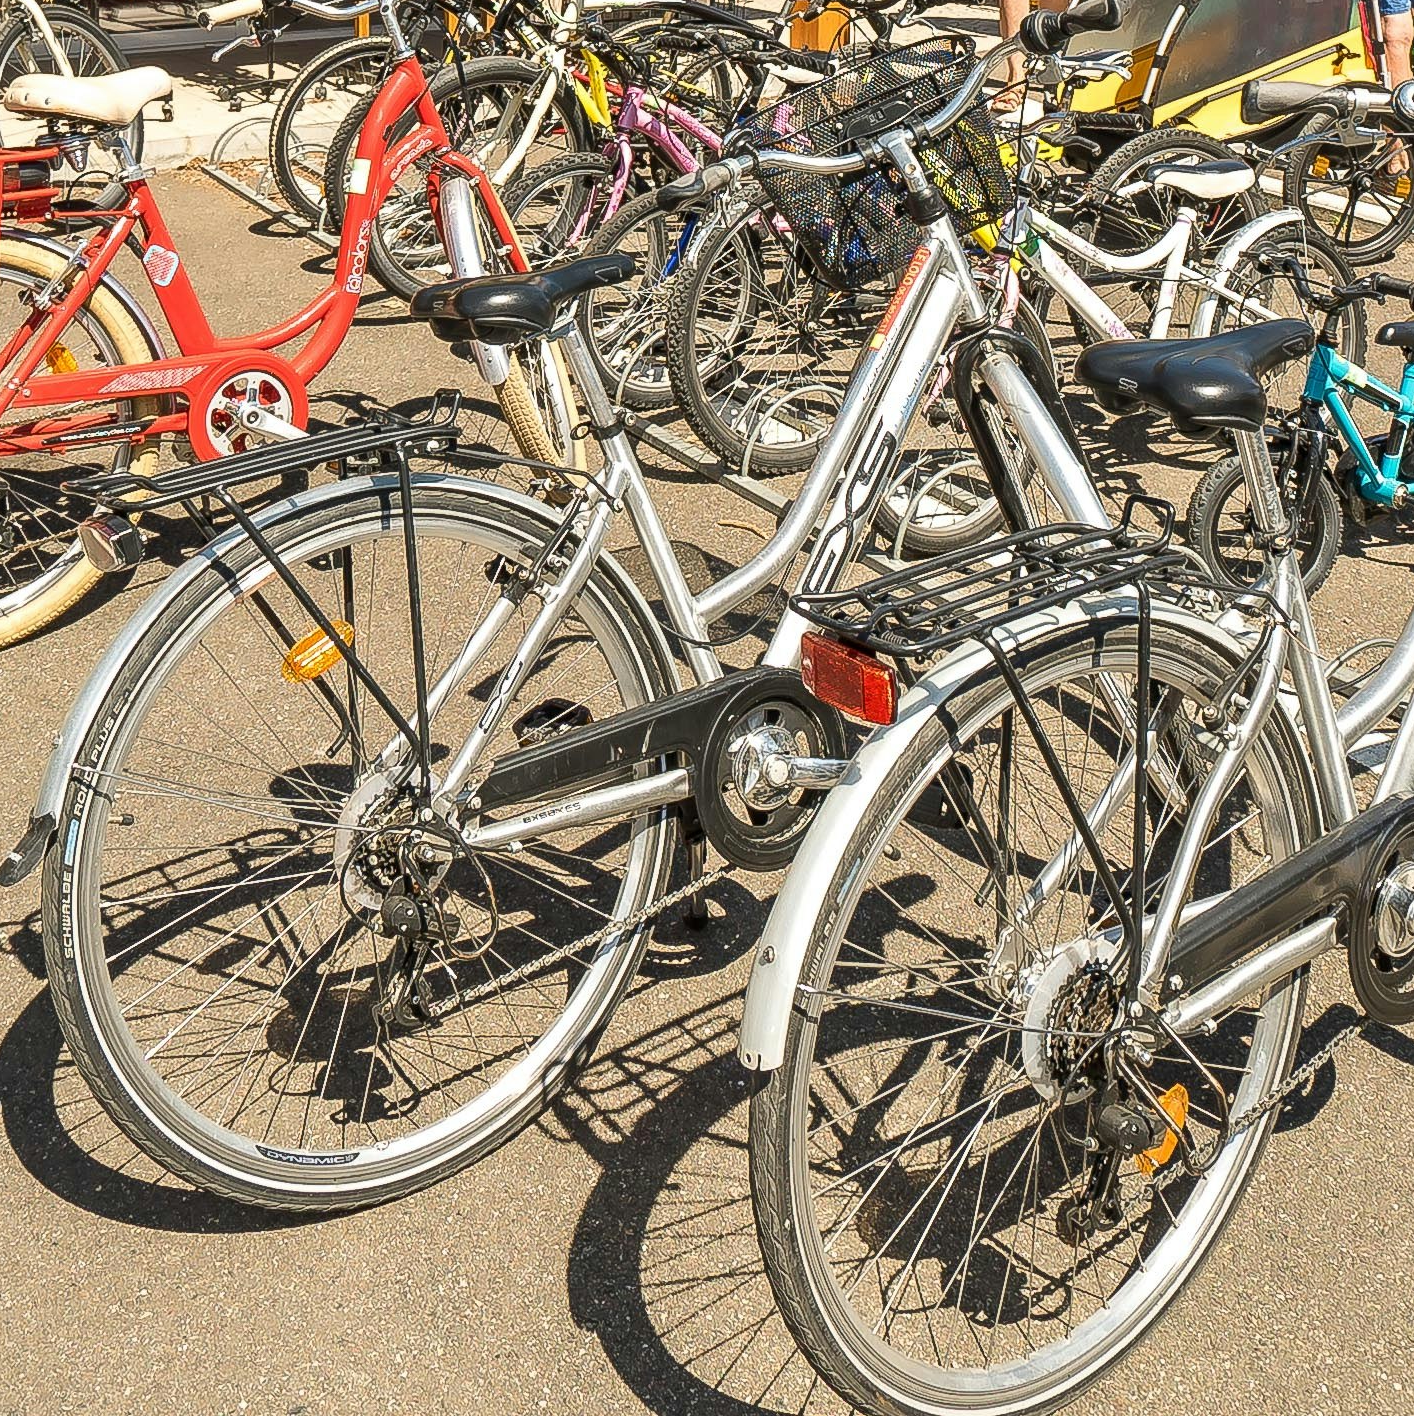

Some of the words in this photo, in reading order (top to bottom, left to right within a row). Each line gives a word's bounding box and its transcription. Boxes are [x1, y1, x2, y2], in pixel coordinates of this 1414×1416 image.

[62, 870, 74, 959] SCHWALBE
[91, 717, 115, 764] PLUS
[267, 1151, 345, 1164] DYNAMIC
